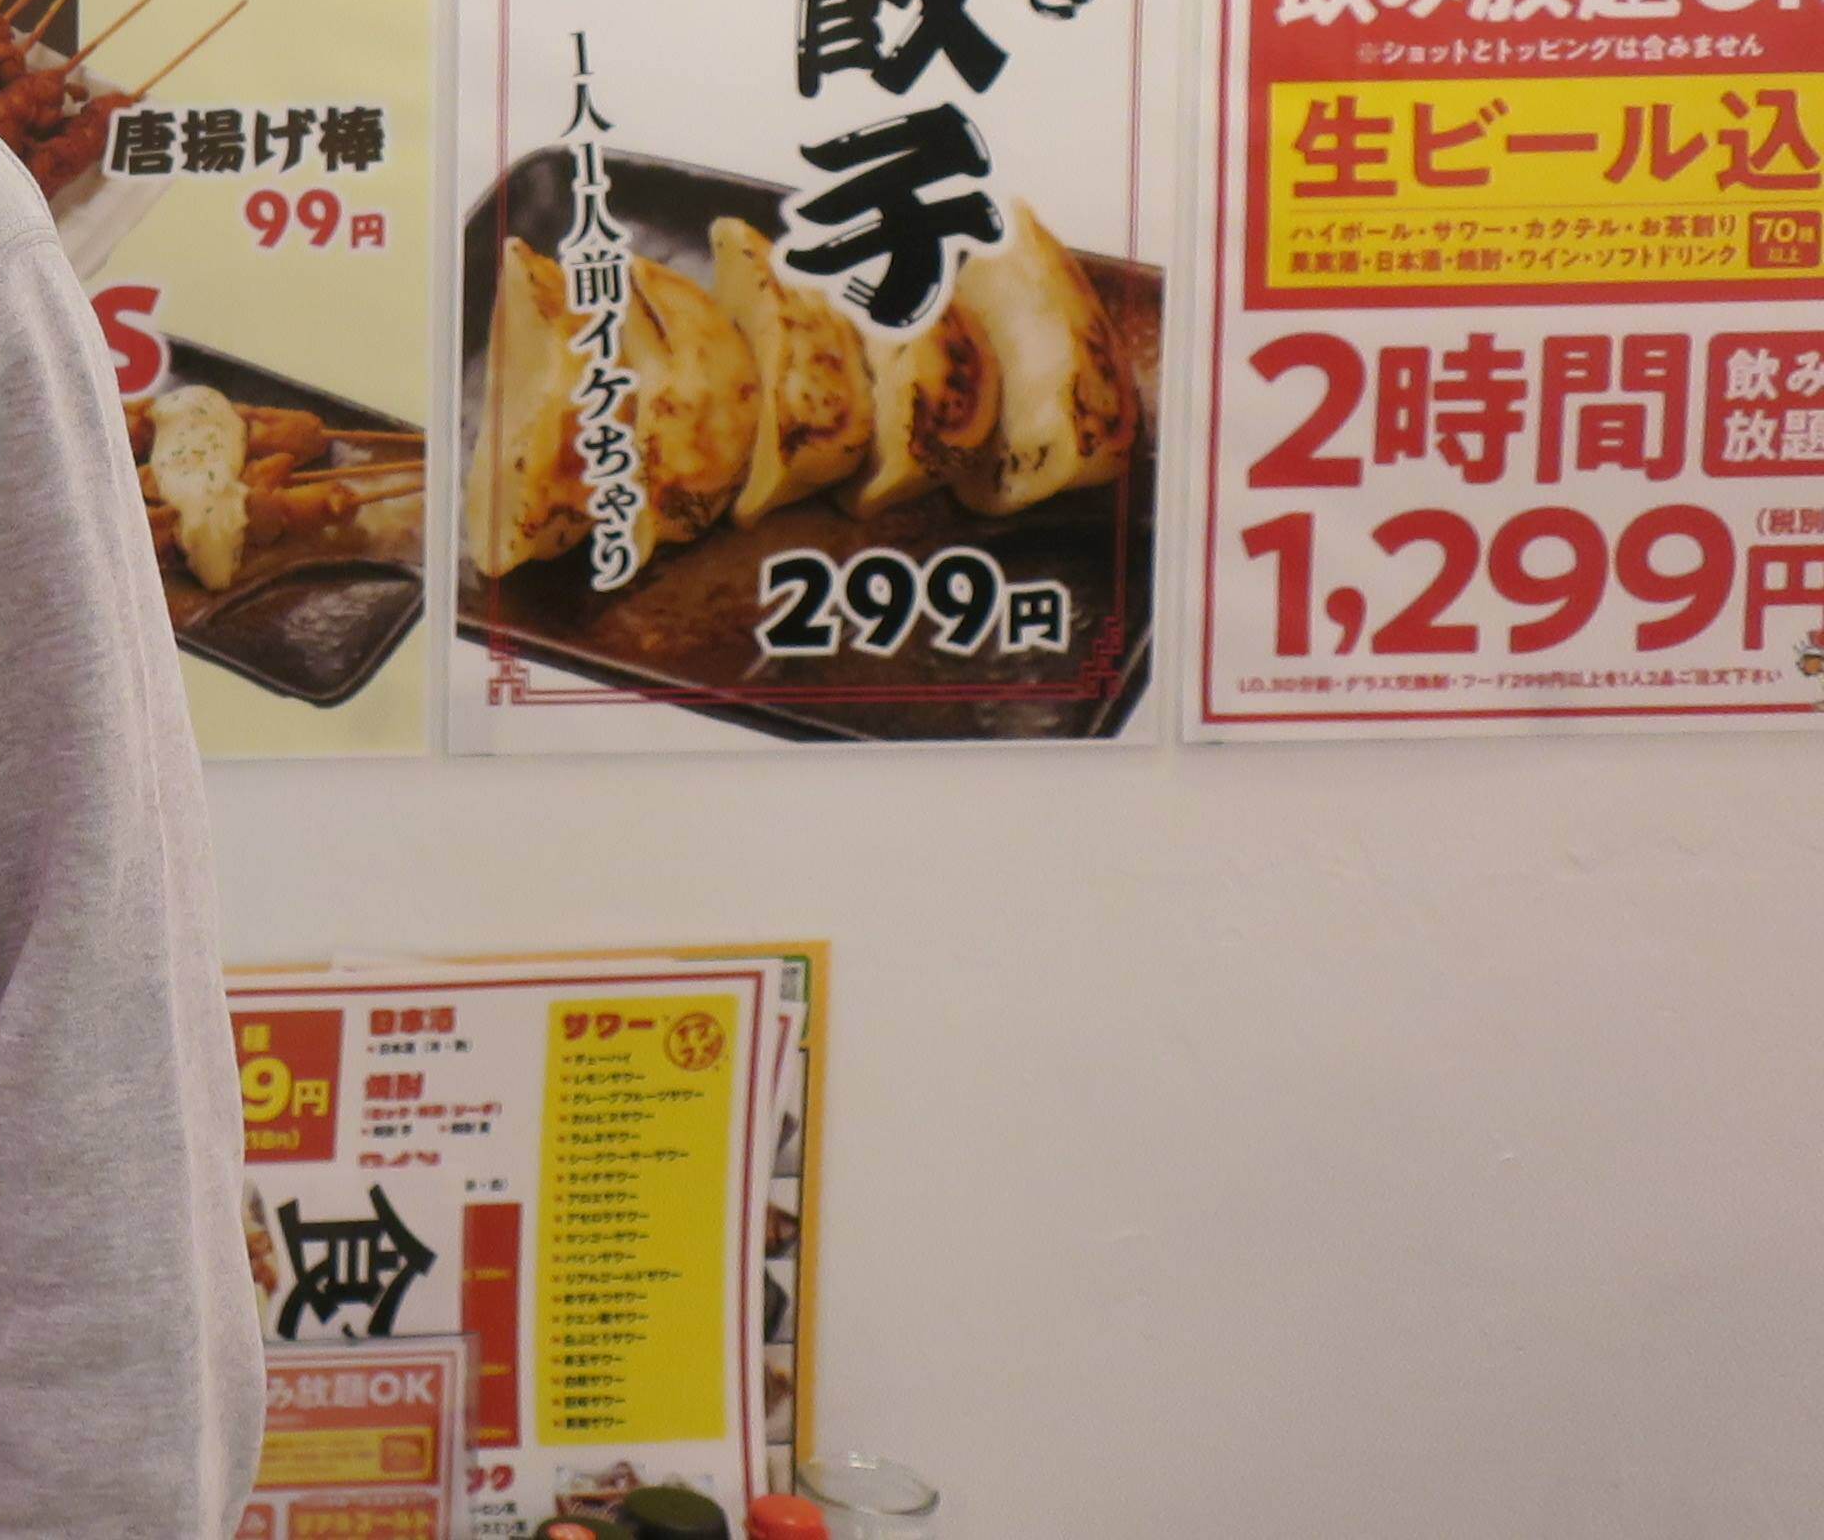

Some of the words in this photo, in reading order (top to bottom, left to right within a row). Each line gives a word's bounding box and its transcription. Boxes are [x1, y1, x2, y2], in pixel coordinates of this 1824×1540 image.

[110, 106, 386, 176] 唐揚げ棒
[1291, 89, 1822, 199] 生ビール込
[244, 188, 386, 248] 99円
[1246, 331, 1692, 489] 2時間
[765, 556, 1062, 649] 299円
[562, 1012, 657, 1041] サワー
